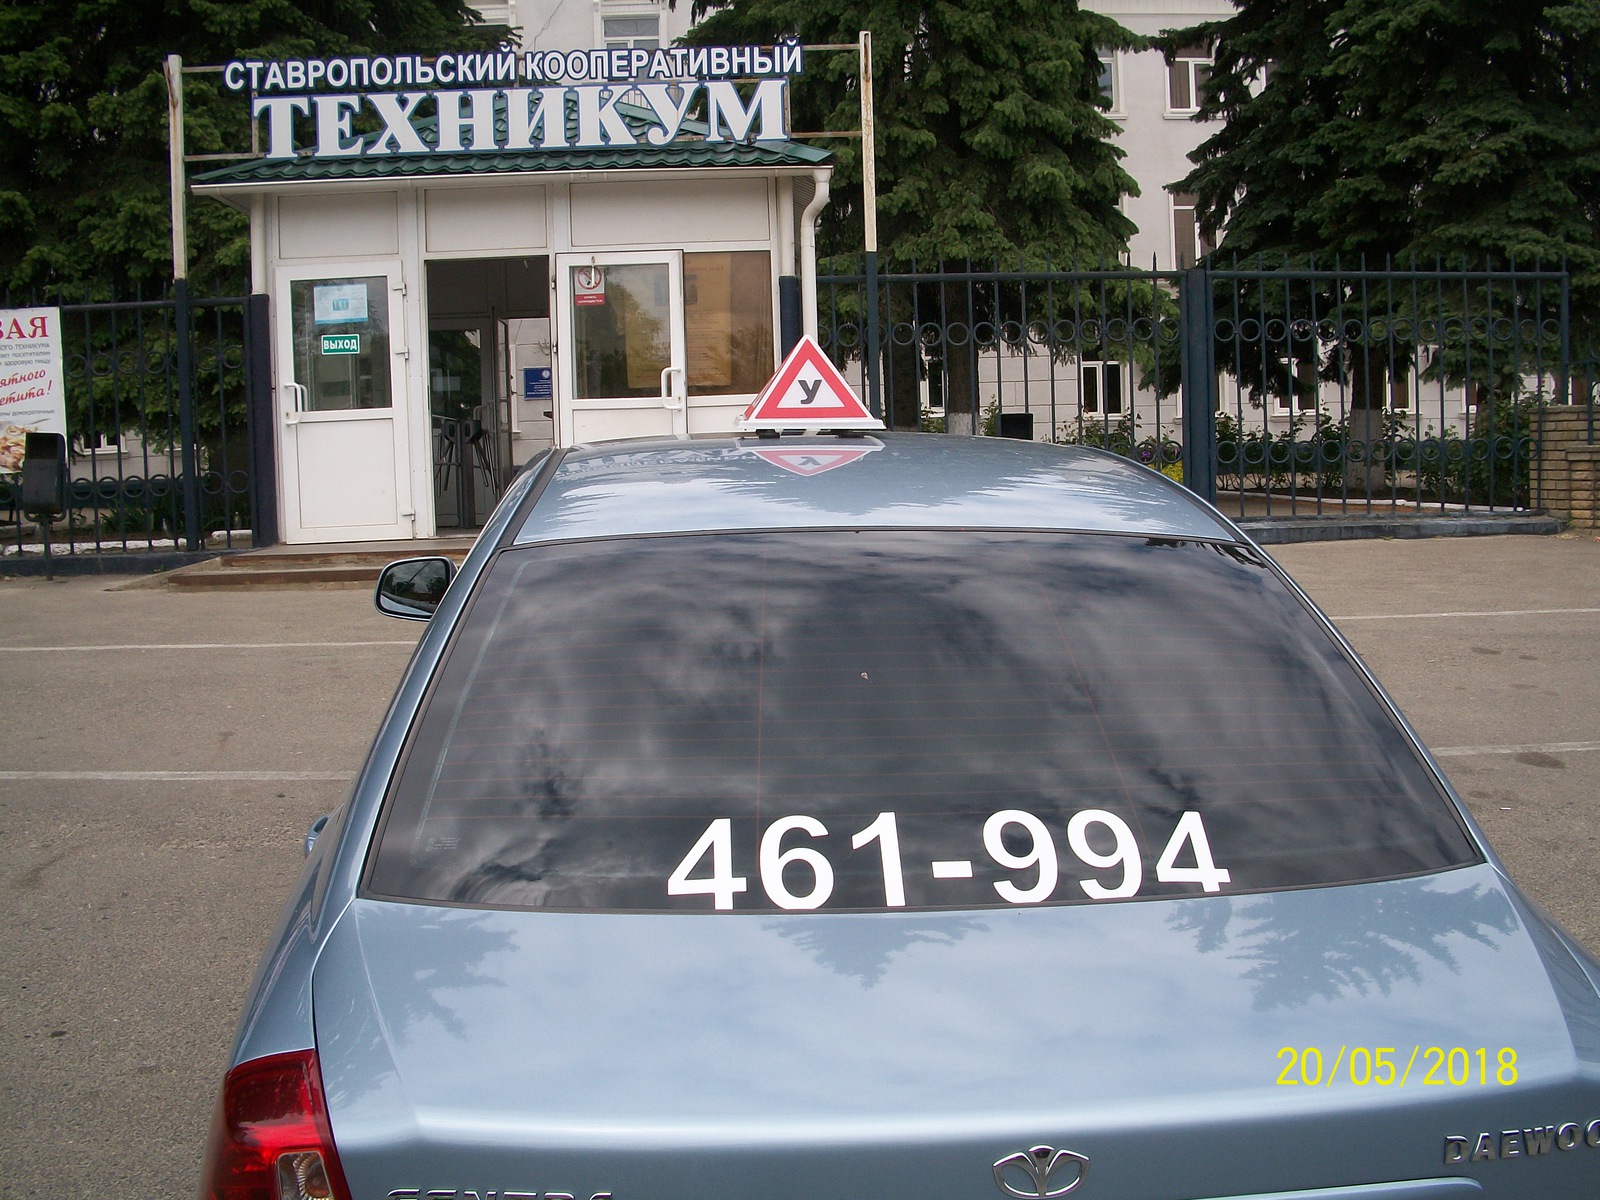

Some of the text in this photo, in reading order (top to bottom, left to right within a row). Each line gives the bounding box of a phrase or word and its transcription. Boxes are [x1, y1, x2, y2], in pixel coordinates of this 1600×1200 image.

[224, 40, 803, 91] СТАВРОПОЛЬСКИЙ КООПЕРАТИВНЫЙ
[252, 79, 790, 159] ТЕХНИКУМ
[0, 315, 49, 340] АЯ
[323, 339, 358, 350] ВЫХОД
[667, 808, 1232, 910] 461-994
